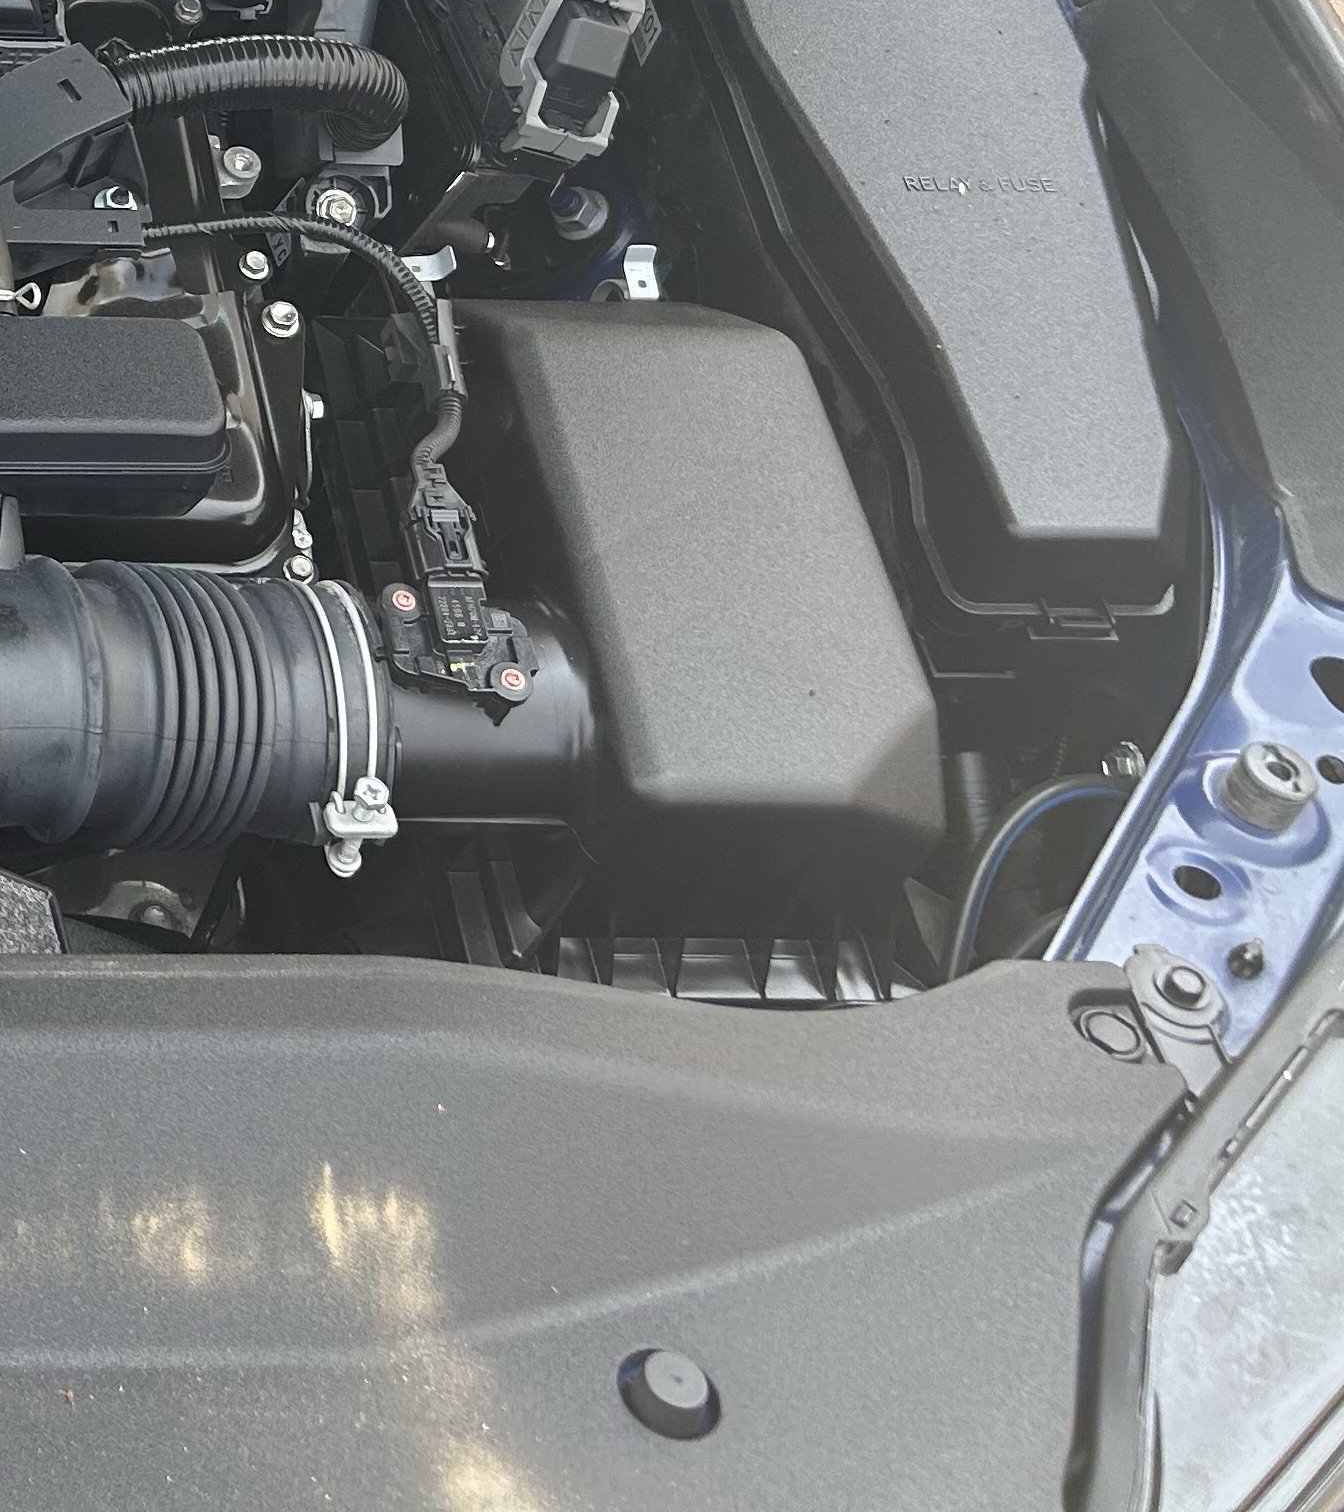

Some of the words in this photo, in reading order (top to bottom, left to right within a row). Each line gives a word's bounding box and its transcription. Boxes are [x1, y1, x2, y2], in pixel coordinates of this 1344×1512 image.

[902, 174, 972, 193] RELAY
[978, 178, 994, 192] &
[997, 176, 1058, 193] FUSE
